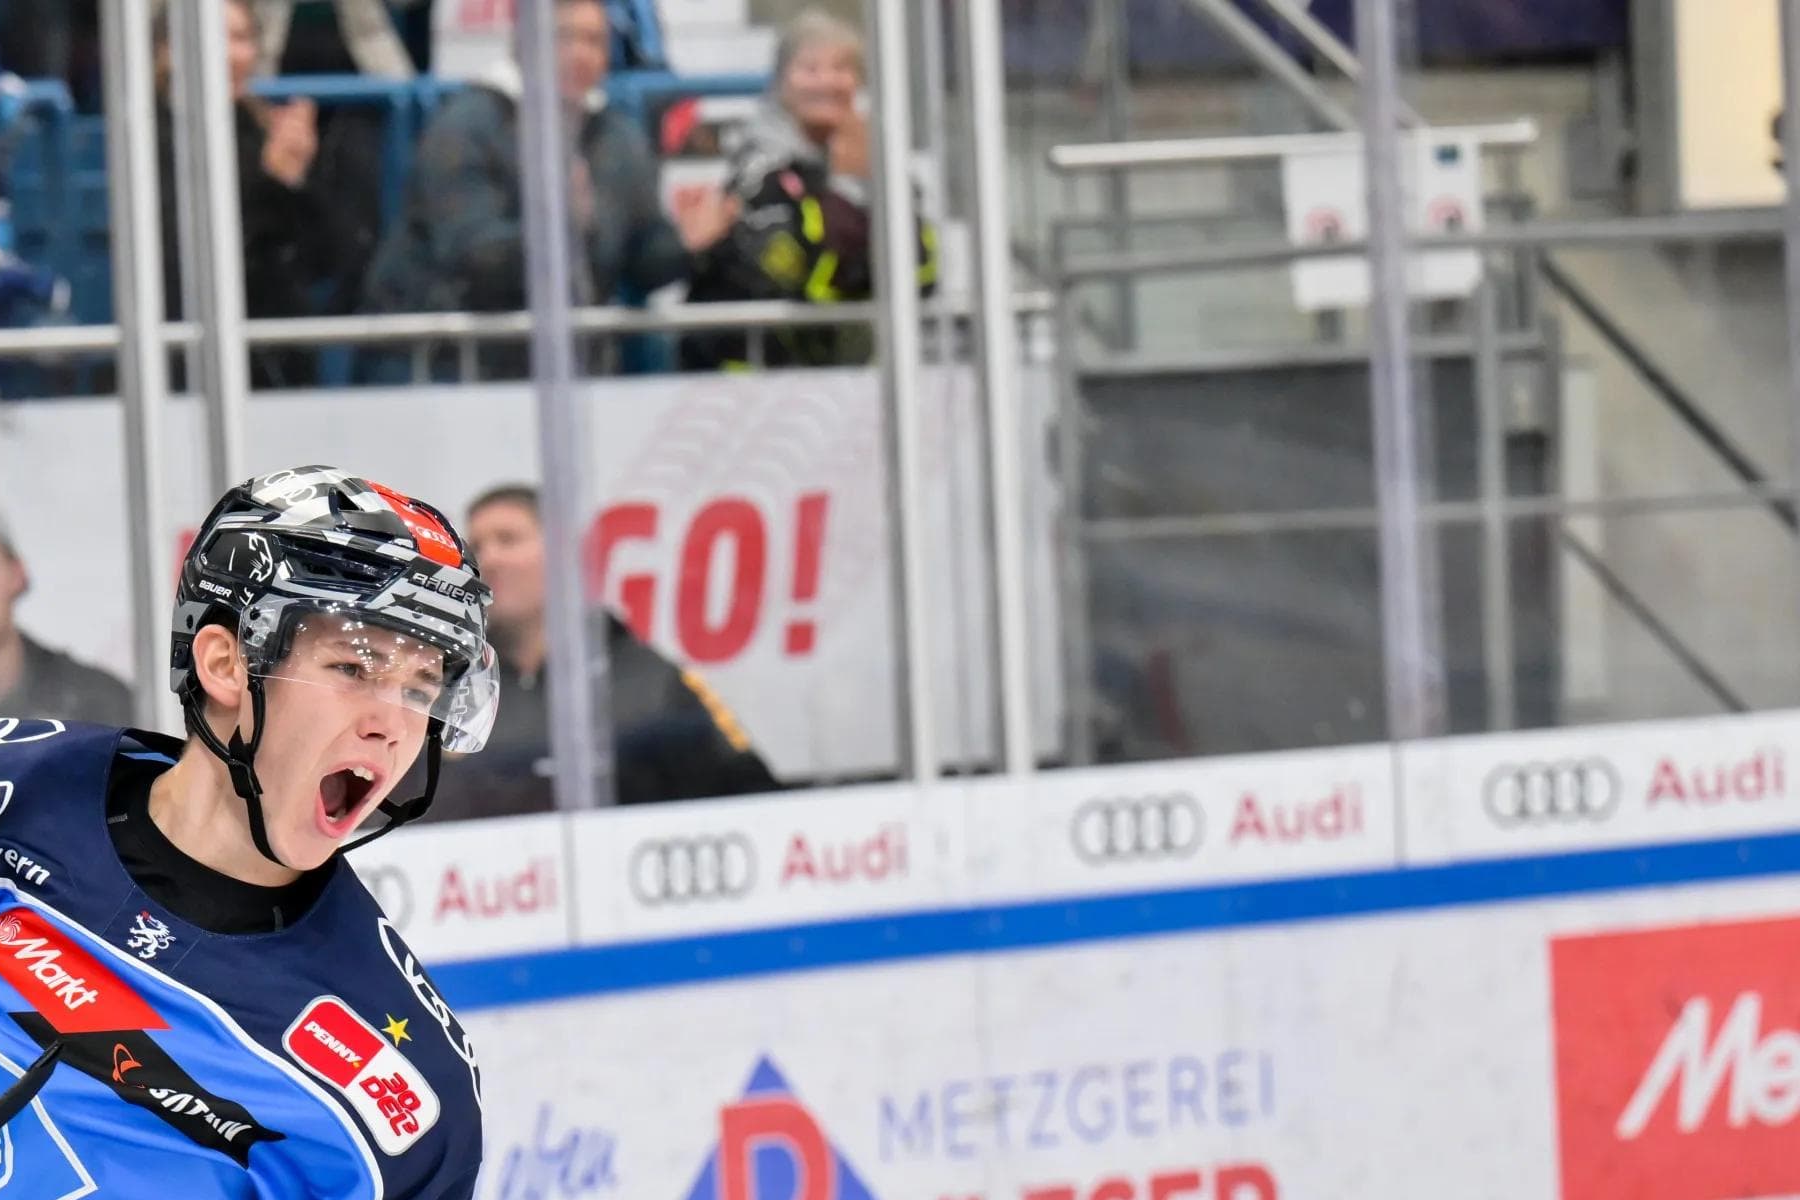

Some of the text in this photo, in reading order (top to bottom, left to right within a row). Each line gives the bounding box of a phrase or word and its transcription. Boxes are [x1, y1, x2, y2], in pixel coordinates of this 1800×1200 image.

[580, 490, 831, 664] GO!
[1645, 748, 1786, 813] Audi
[1227, 781, 1365, 848] Audi
[779, 822, 909, 887] Audi
[434, 856, 558, 923] Audi
[13, 936, 99, 1011] Markt
[877, 1047, 1276, 1164] METZGEREI
